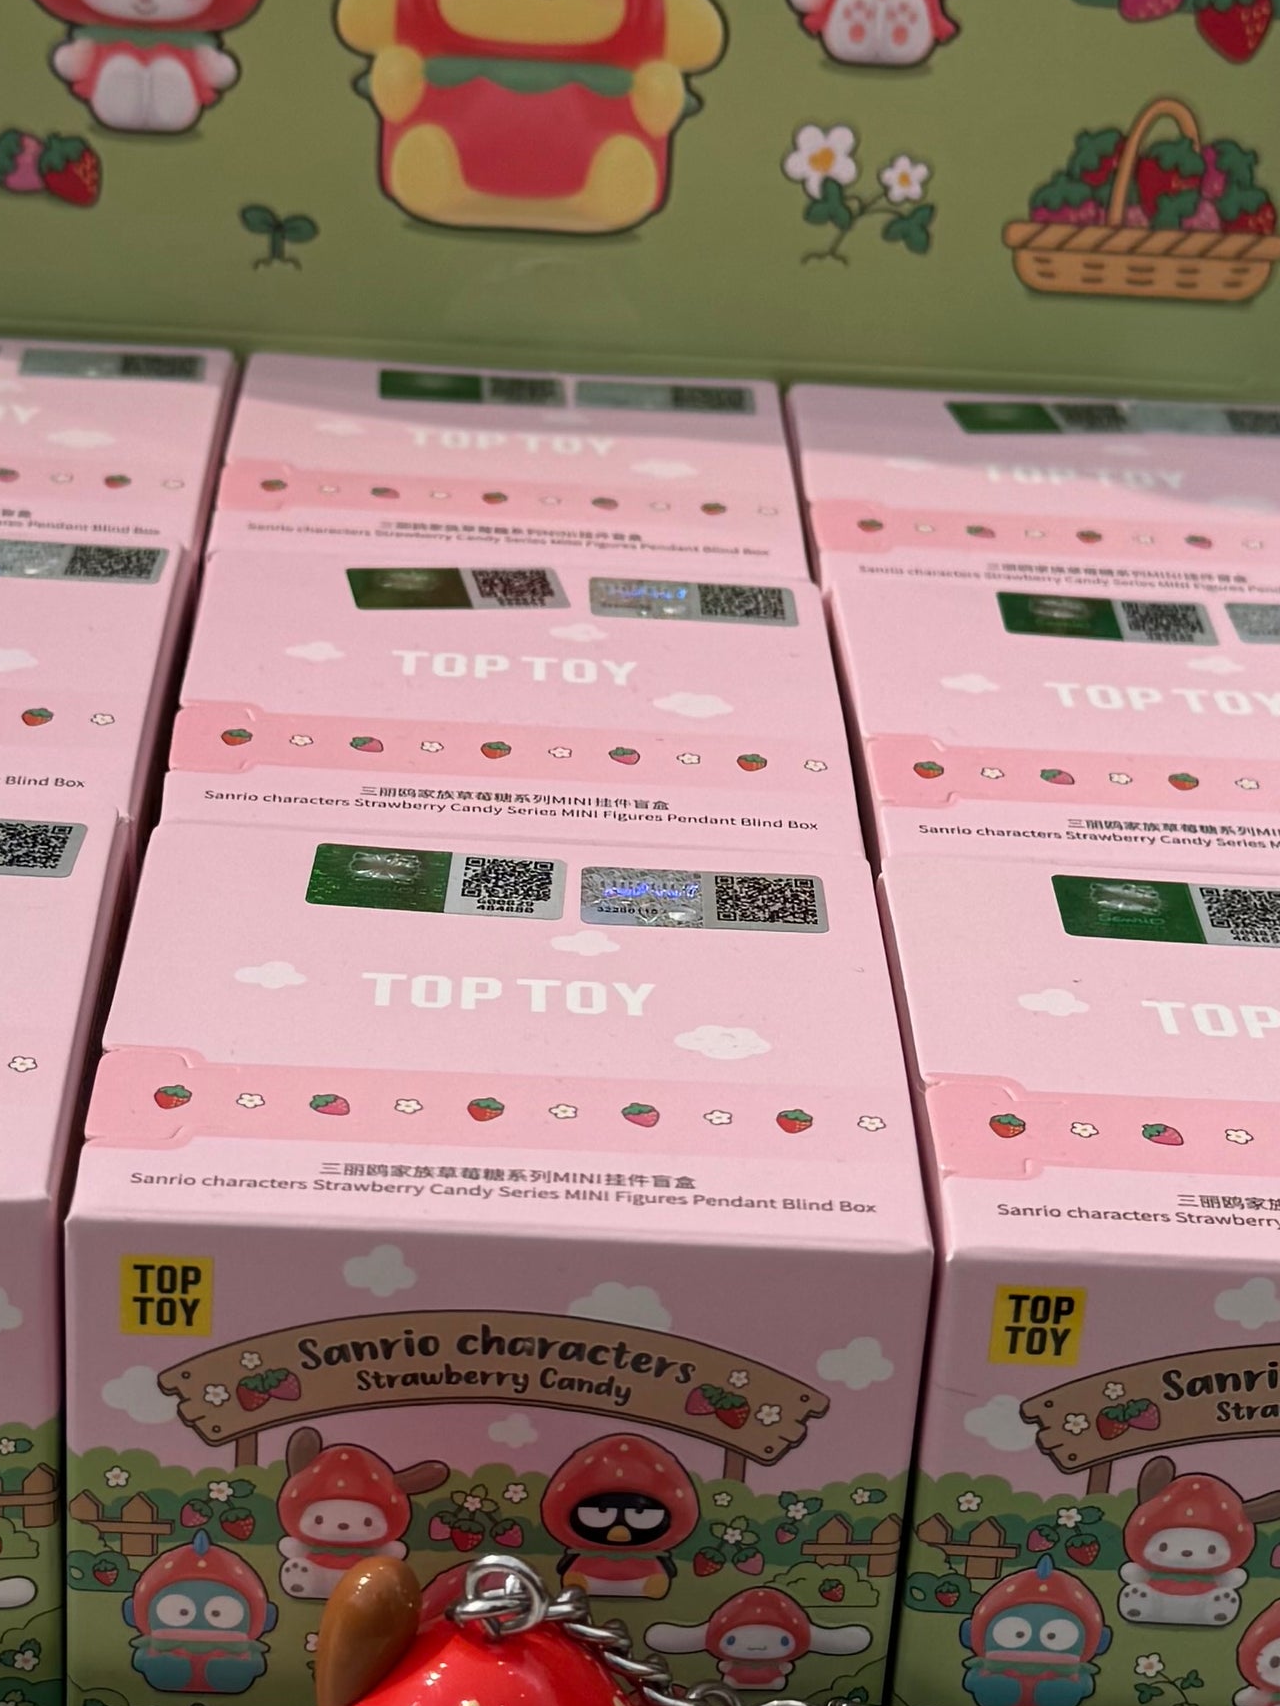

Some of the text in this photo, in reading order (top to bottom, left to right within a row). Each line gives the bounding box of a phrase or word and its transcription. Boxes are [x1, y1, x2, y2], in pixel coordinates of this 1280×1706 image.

[406, 428, 617, 456] TOP TOY
[986, 462, 1187, 490] TOP TOY
[392, 650, 638, 686] TOP TOY
[1044, 680, 1164, 712] TOP
[5, 775, 49, 787] Blind
[54, 777, 85, 788] Box
[204, 791, 818, 829] Sanrio characters Strawberry Candy Series MINI Figures Pendant Blind Box
[919, 825, 972, 836] Sanrio
[976, 827, 1062, 840] characters
[1065, 831, 1156, 848] Strawberry
[1160, 835, 1212, 851] Candy
[1216, 838, 1266, 849] Series
[363, 972, 656, 1017] TOP TOY
[131, 1173, 876, 1213] Sanrio characters Strawberry Candy Series MINI Figures Pendant Blind Box
[997, 1204, 1061, 1218] Sanrio
[1067, 1207, 1171, 1223] characters
[133, 1263, 202, 1294] TOP
[133, 1297, 201, 1327] TOY
[1006, 1295, 1076, 1324] TOP
[298, 1327, 697, 1385] Sanrio characters
[1004, 1327, 1072, 1357] TOY
[356, 1364, 632, 1407] Strawberry Candy
